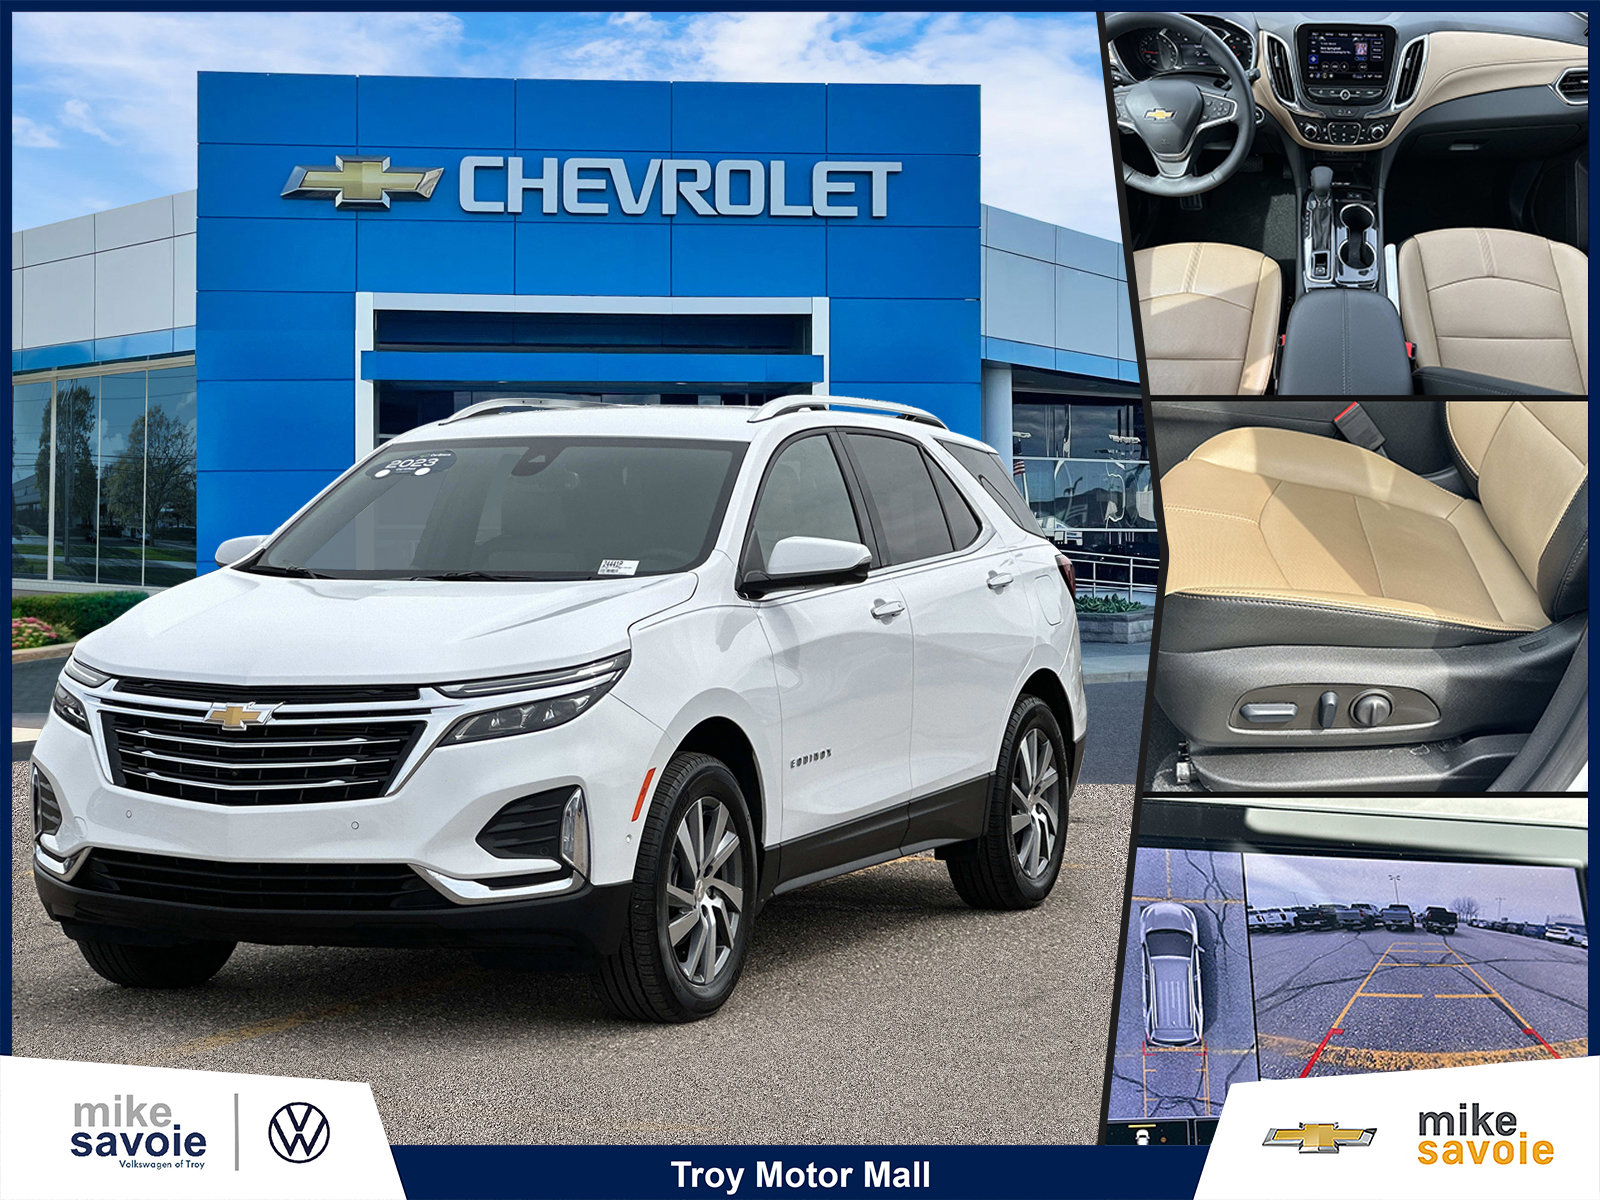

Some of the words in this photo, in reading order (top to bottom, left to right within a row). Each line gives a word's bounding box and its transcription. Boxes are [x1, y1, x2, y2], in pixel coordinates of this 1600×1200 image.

[459, 156, 903, 217] CHEVROLET
[385, 457, 440, 469] 2023
[790, 748, 832, 769] EQUINOX
